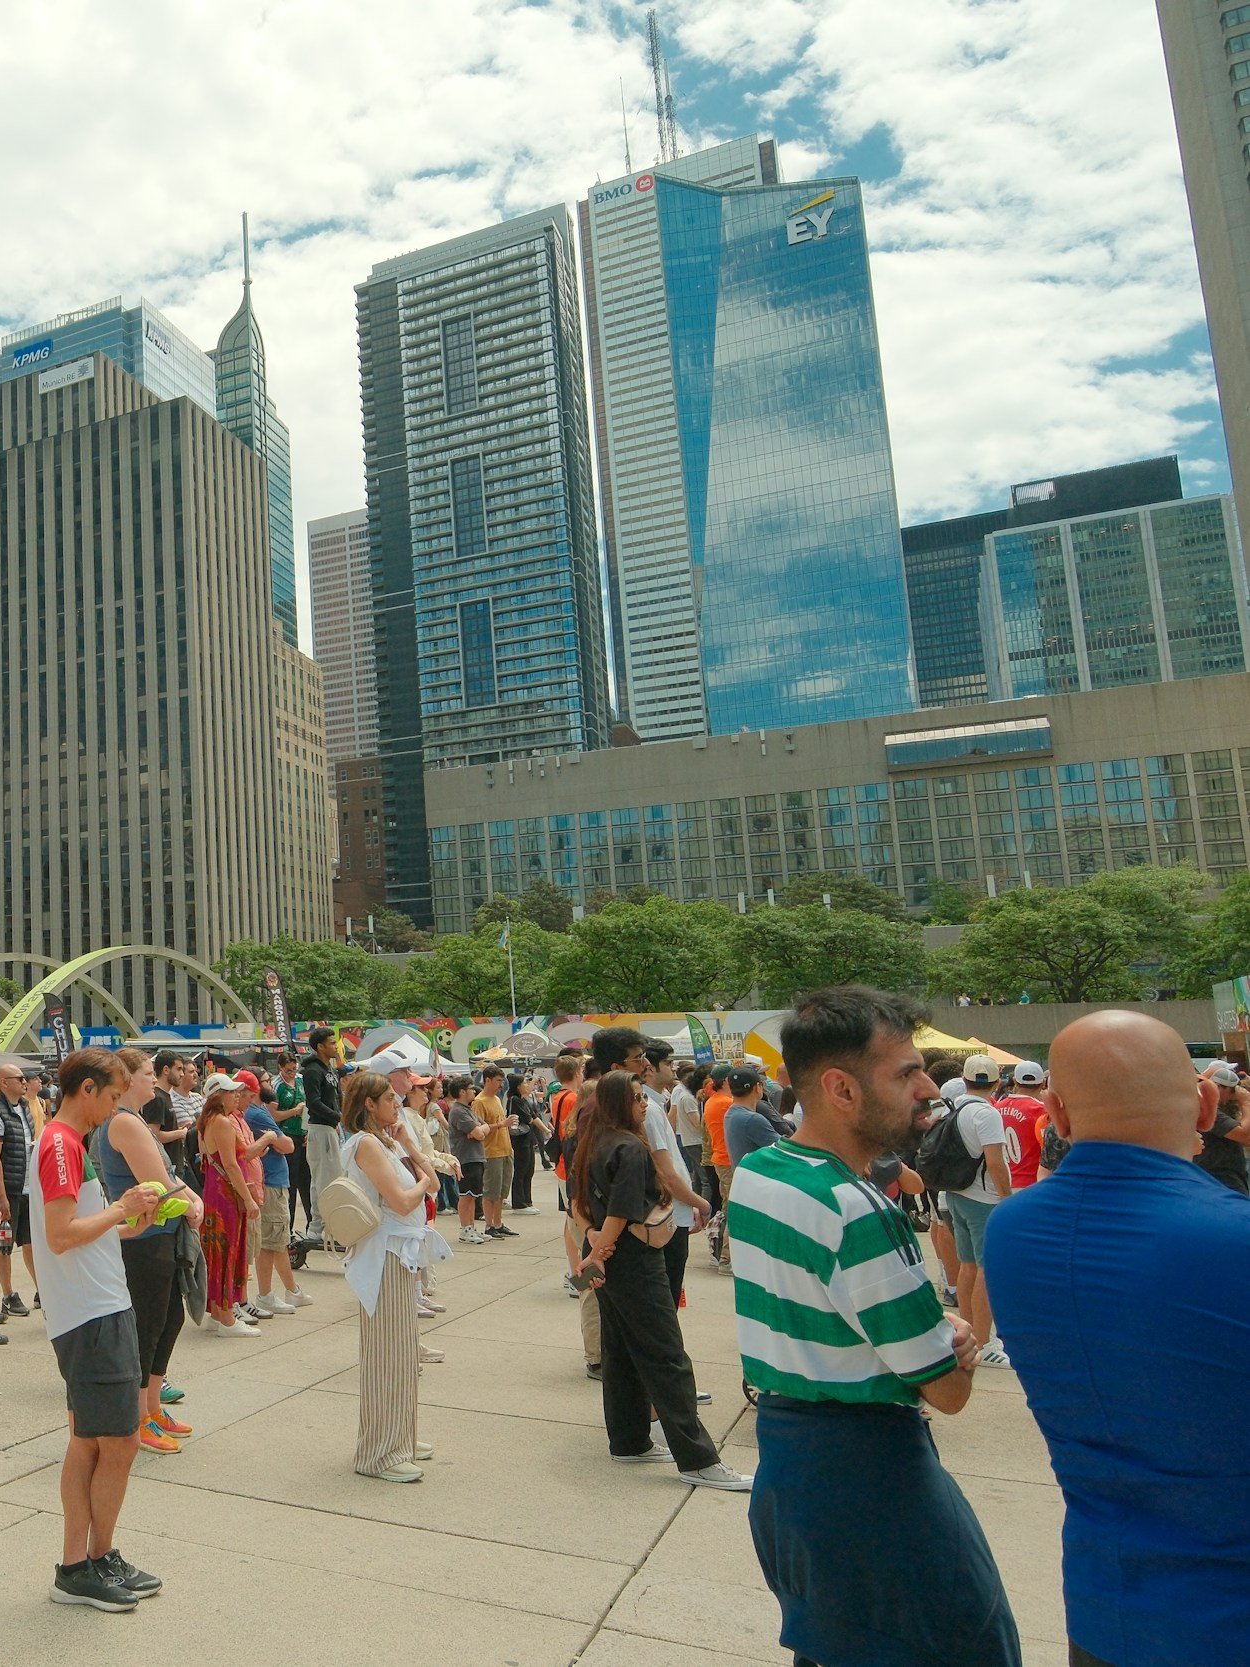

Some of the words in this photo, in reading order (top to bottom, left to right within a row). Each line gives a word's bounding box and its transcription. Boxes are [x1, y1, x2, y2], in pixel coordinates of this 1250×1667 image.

[594, 183, 632, 204] BMO
[786, 208, 835, 245] EY
[12, 346, 51, 369] KPMG
[41, 376, 66, 389] Munich
[66, 373, 76, 382] RE
[14, 1003, 31, 1019] CUP
[89, 1035, 112, 1046] ARE
[53, 1132, 68, 1186] DESAFIADOR
